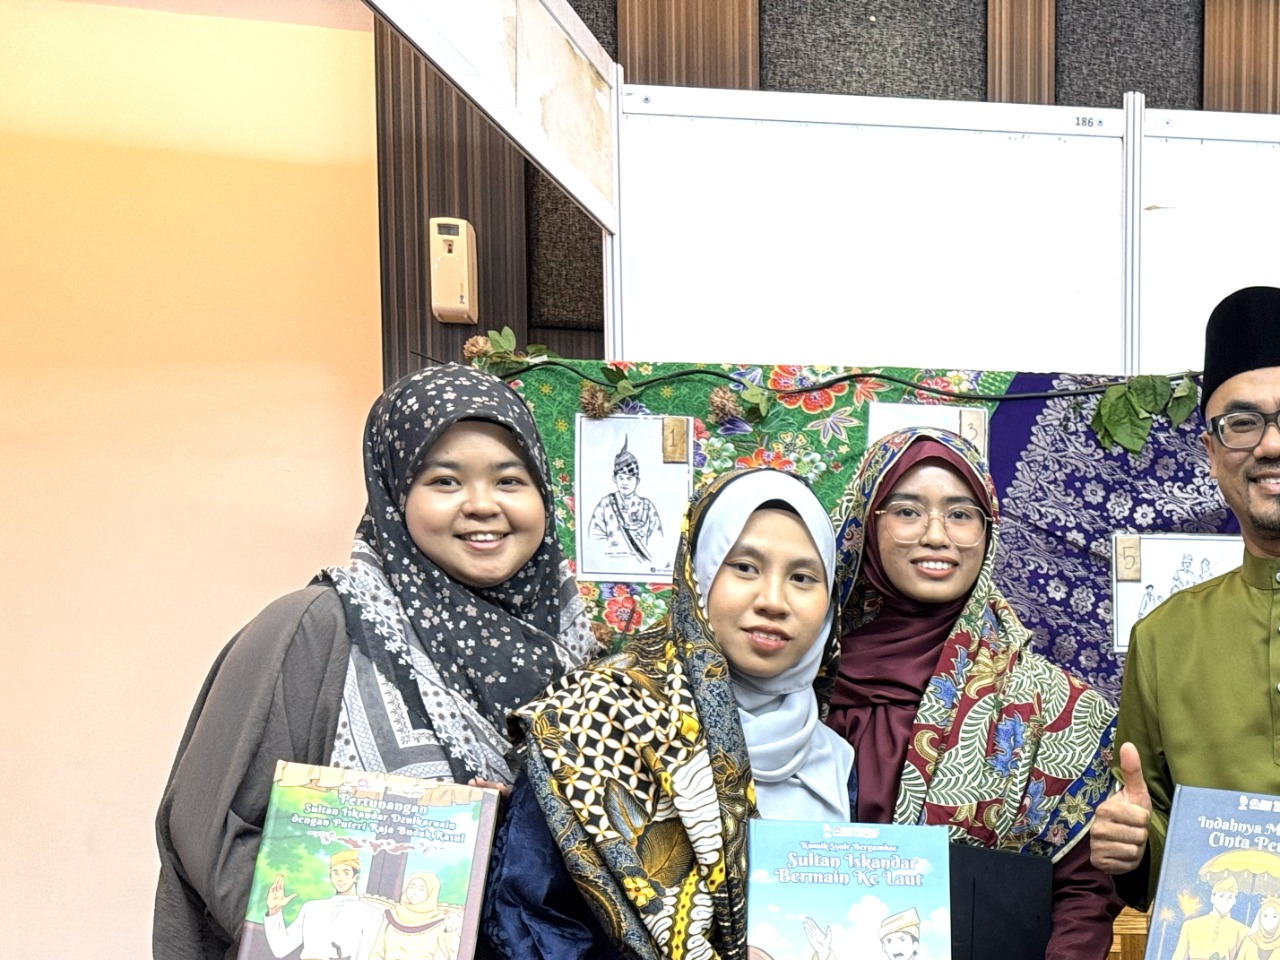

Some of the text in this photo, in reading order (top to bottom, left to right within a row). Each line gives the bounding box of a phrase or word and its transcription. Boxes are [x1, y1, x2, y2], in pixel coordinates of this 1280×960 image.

[1075, 116, 1094, 127] 186
[668, 429, 678, 447] 1
[1122, 546, 1136, 570] 5
[338, 793, 428, 815] Pertunangan
[291, 813, 330, 827] dengan
[332, 818, 367, 830] Puteri
[369, 821, 394, 835] Raja
[304, 803, 456, 831] Sultan Iskandar Dzulkarnain
[1198, 815, 1262, 835] Indahnya
[1208, 831, 1250, 849] Cinta
[786, 851, 919, 870] Sultan Iskandar
[774, 867, 924, 887] Bermain Ke Laut
